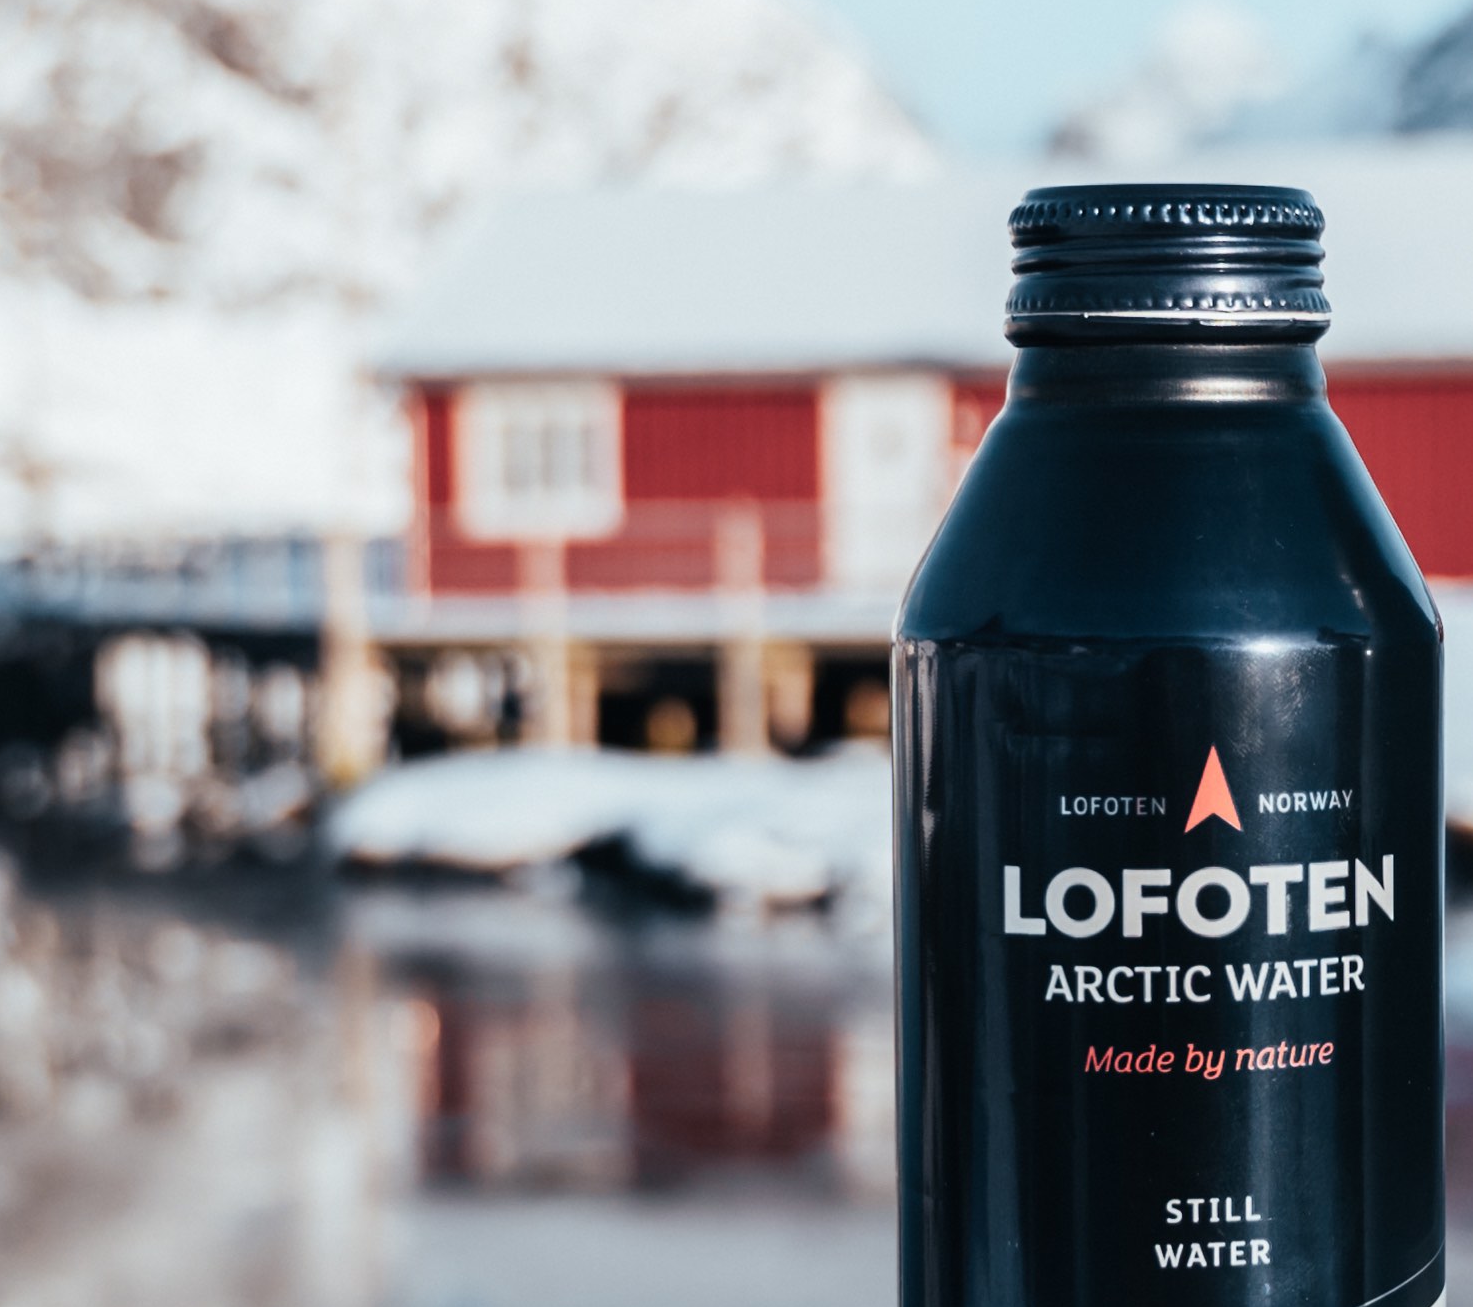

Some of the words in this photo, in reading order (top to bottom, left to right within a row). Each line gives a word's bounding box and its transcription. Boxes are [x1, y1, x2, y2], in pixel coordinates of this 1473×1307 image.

[1060, 795, 1167, 816] LOFOTEN
[1258, 788, 1353, 814] NORWAY
[1003, 854, 1395, 938] LOFOTEN
[1045, 965, 1212, 1003] ARCTIC
[1226, 955, 1366, 1000] WATER
[1085, 1045, 1173, 1073] Made
[1184, 1043, 1226, 1080] by
[1235, 1041, 1335, 1071] nature
[1166, 1196, 1262, 1223] STILL
[1155, 1239, 1271, 1268] WATER
